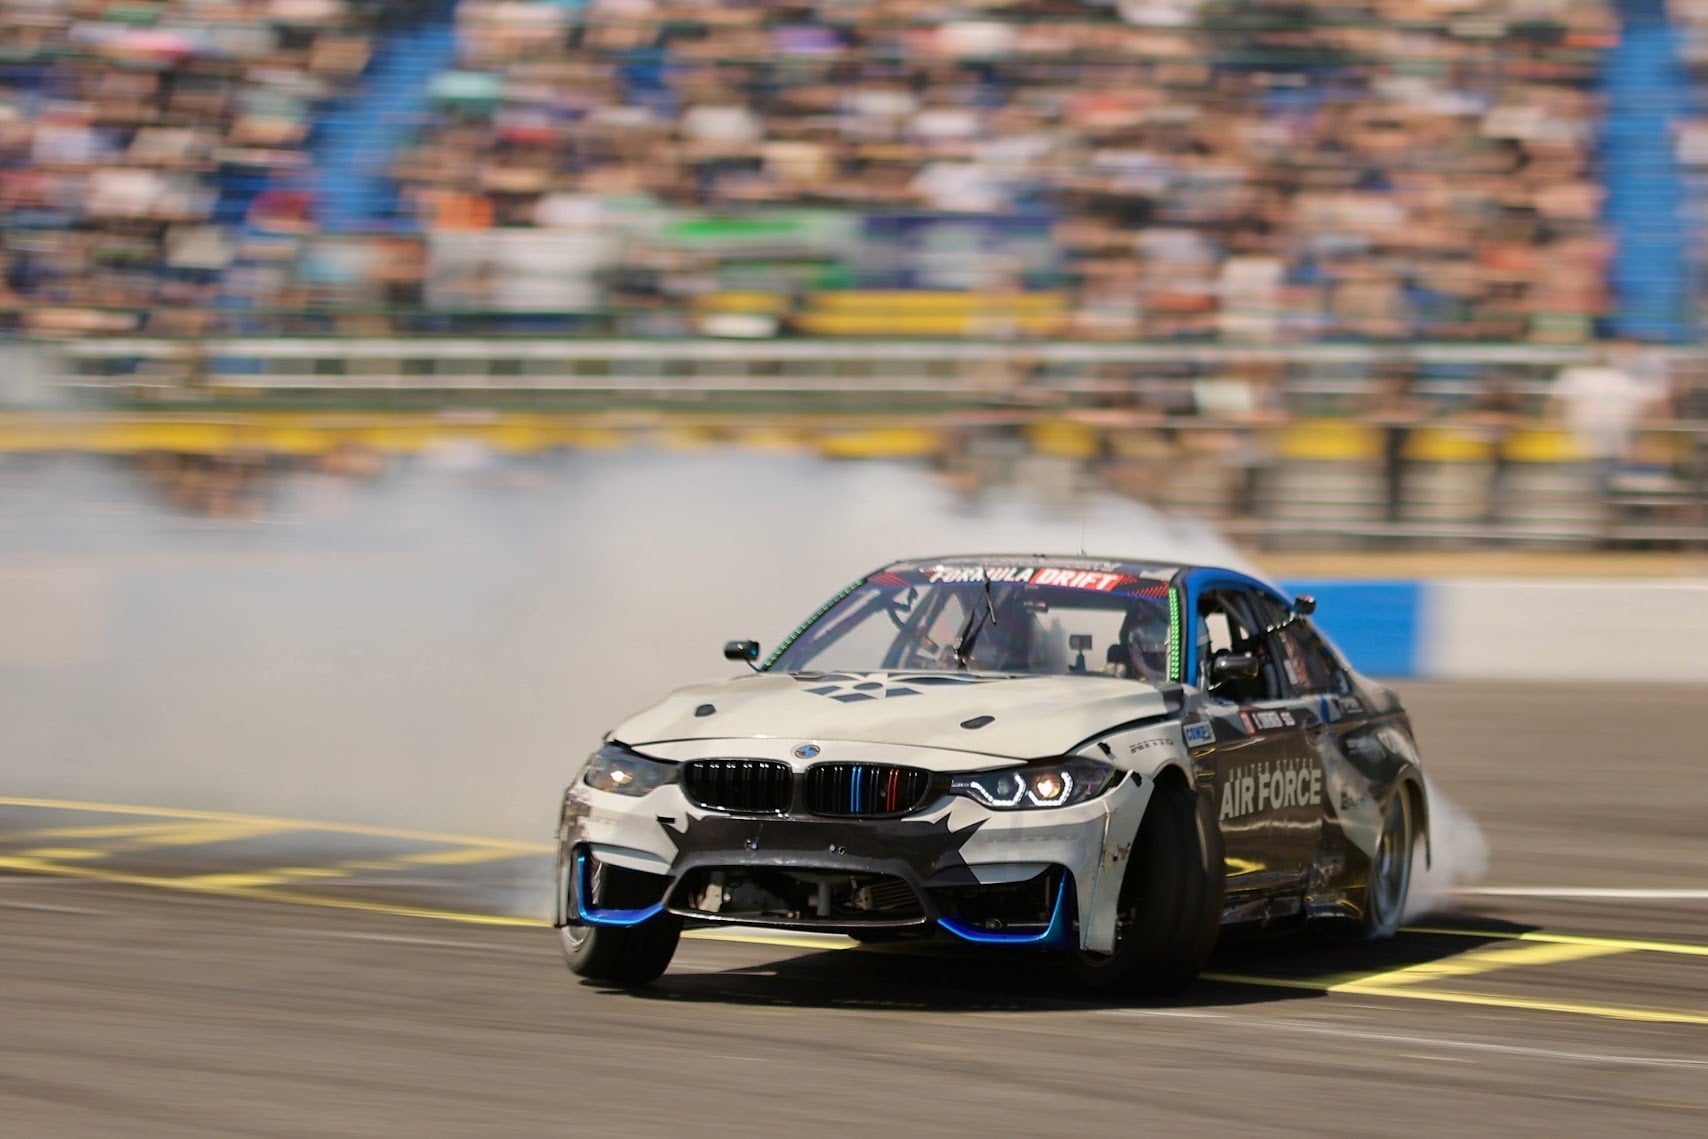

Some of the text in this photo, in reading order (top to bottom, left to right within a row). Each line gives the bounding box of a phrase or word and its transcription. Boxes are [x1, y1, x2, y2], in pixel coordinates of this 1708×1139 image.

[928, 565, 1119, 590] FORMULA DRIFT
[1219, 777, 1254, 821] AIR
[1259, 769, 1321, 811] FORCE
